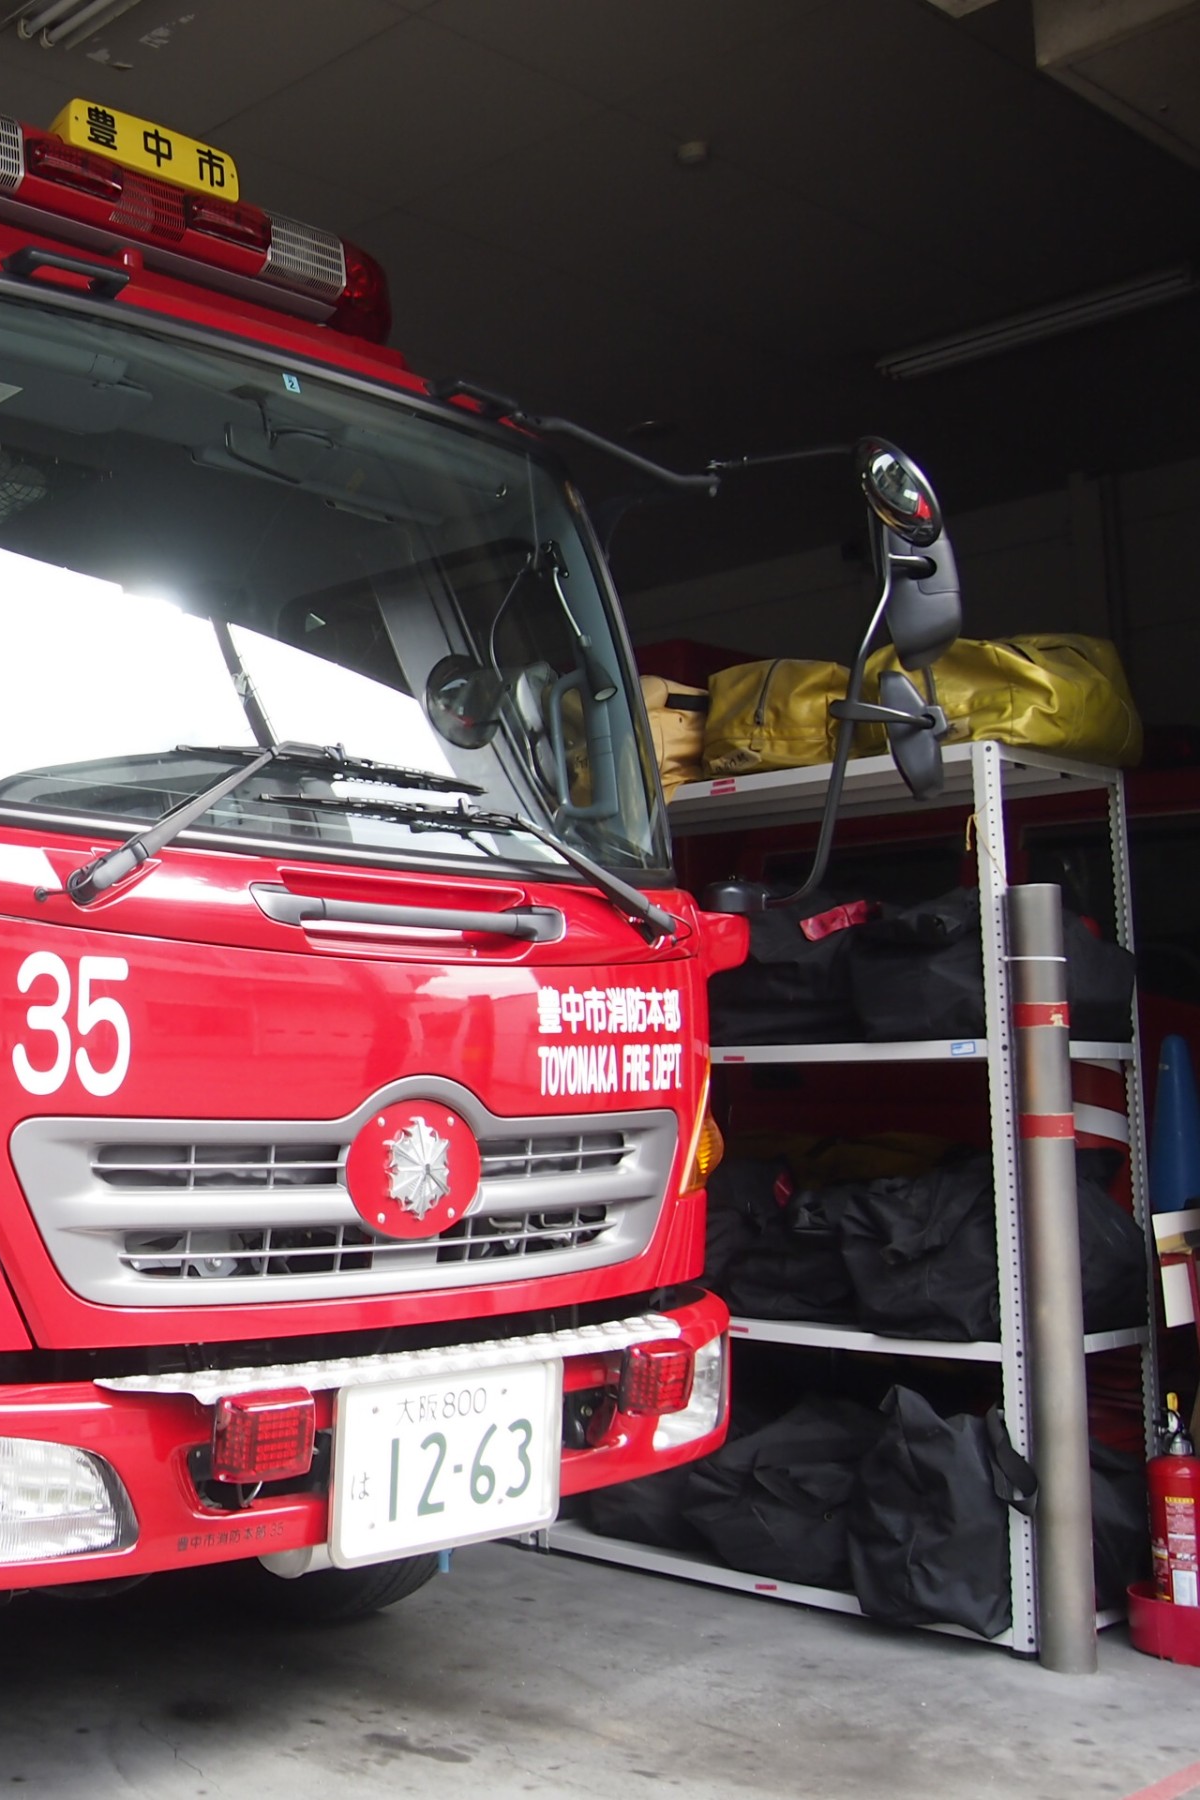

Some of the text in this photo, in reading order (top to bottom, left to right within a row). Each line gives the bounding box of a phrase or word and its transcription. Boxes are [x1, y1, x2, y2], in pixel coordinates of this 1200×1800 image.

[86, 106, 225, 187] 豊中市
[12, 951, 131, 1097] 35
[537, 986, 682, 1034] 豊中市消防本部
[537, 1045, 619, 1096] TOYONAKA
[622, 1044, 650, 1092] FIRE
[351, 1471, 370, 1500] は
[389, 1418, 533, 1522] 12-63
